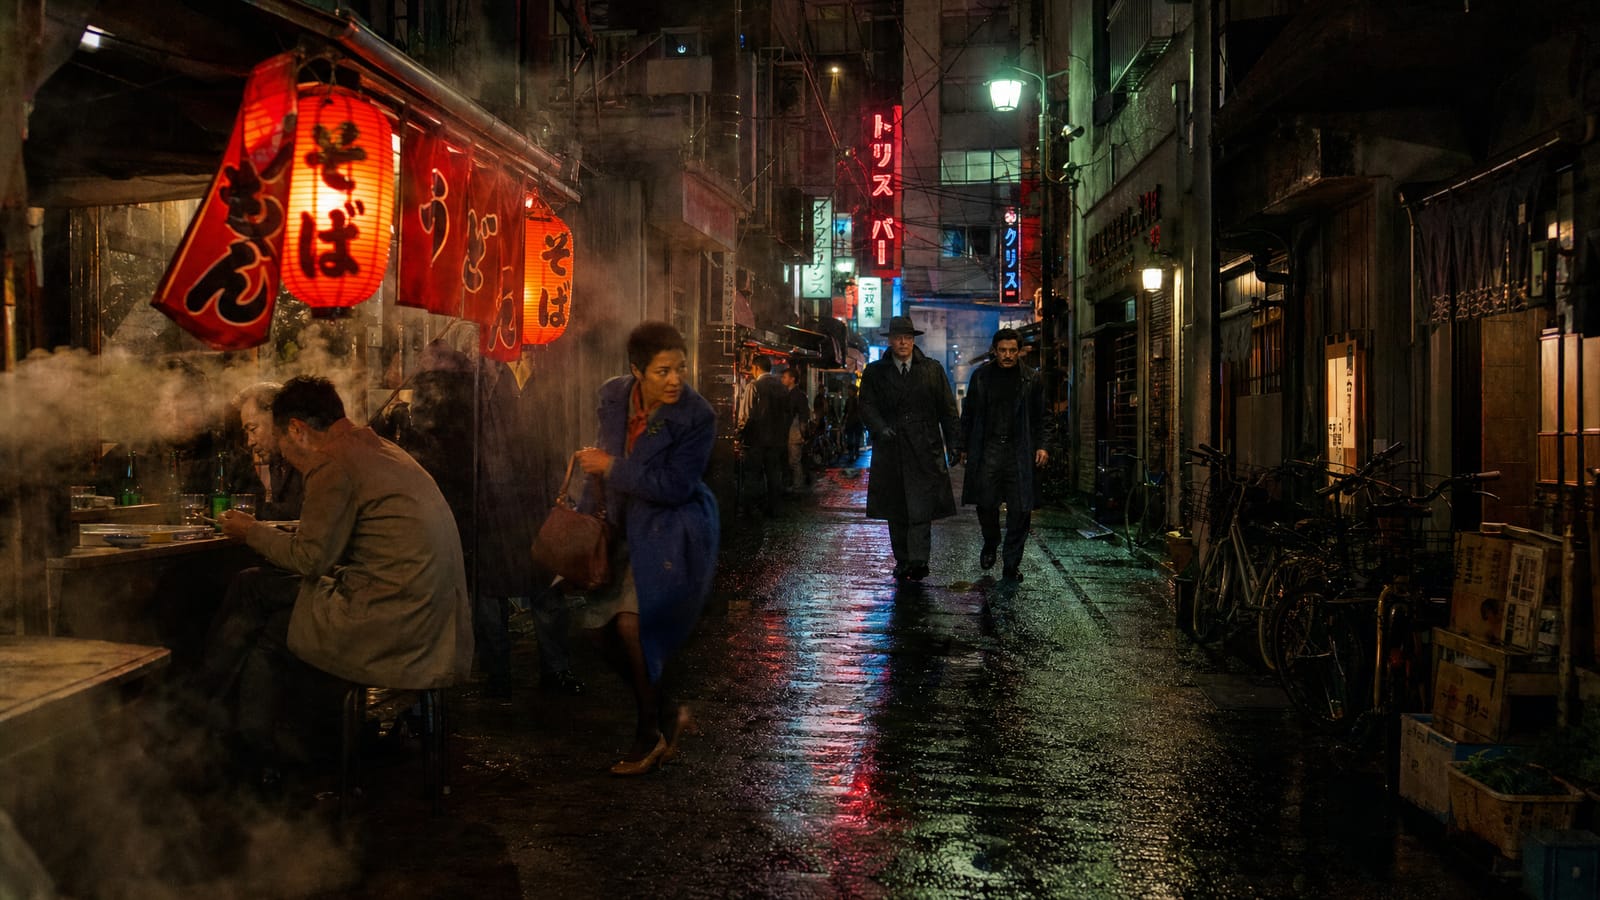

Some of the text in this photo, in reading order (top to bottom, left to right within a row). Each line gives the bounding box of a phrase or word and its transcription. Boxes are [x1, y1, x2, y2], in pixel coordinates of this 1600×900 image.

[299, 120, 368, 278] そば
[872, 114, 894, 197] トリス
[538, 231, 572, 329] そば
[1004, 227, 1018, 289] クリス
